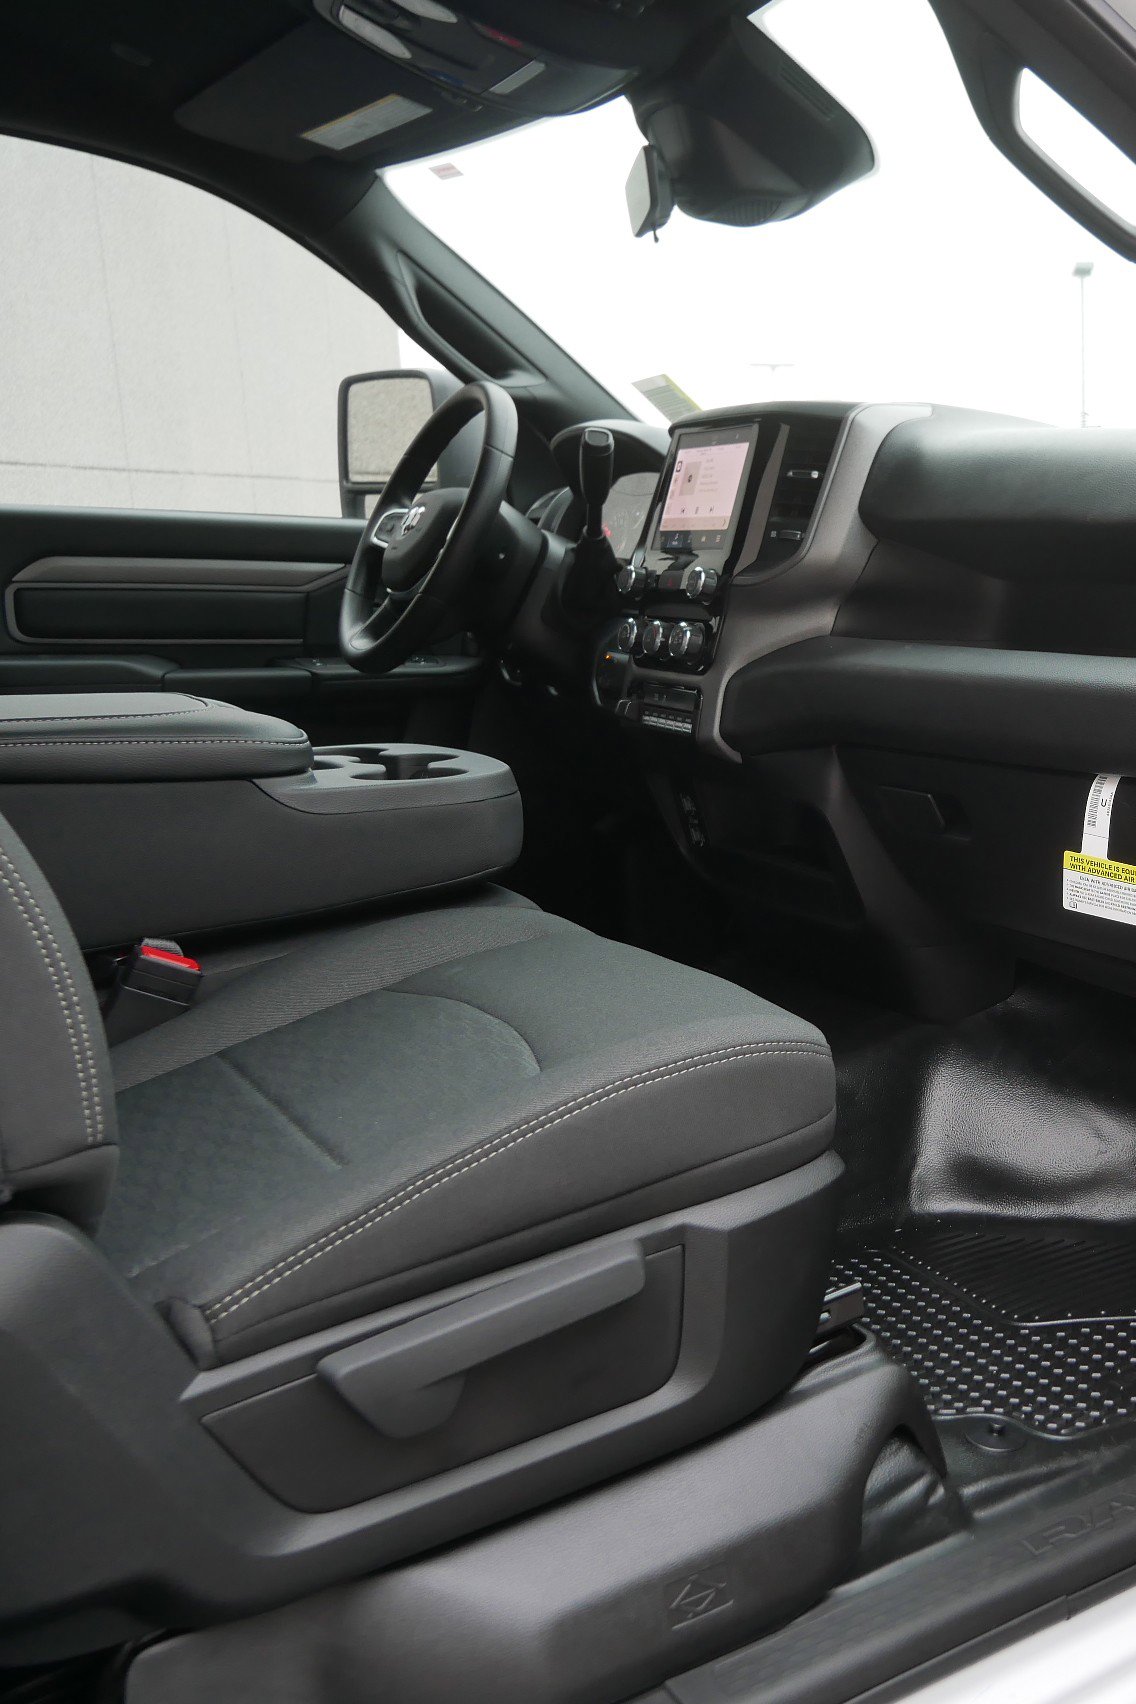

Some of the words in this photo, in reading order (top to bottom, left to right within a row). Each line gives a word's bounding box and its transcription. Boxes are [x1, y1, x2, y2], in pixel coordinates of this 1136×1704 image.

[1069, 855, 1084, 865] THIS
[1085, 859, 1112, 871] VEHICLE
[1069, 862, 1086, 872] WITH
[1087, 866, 1122, 880] ADVANCED
